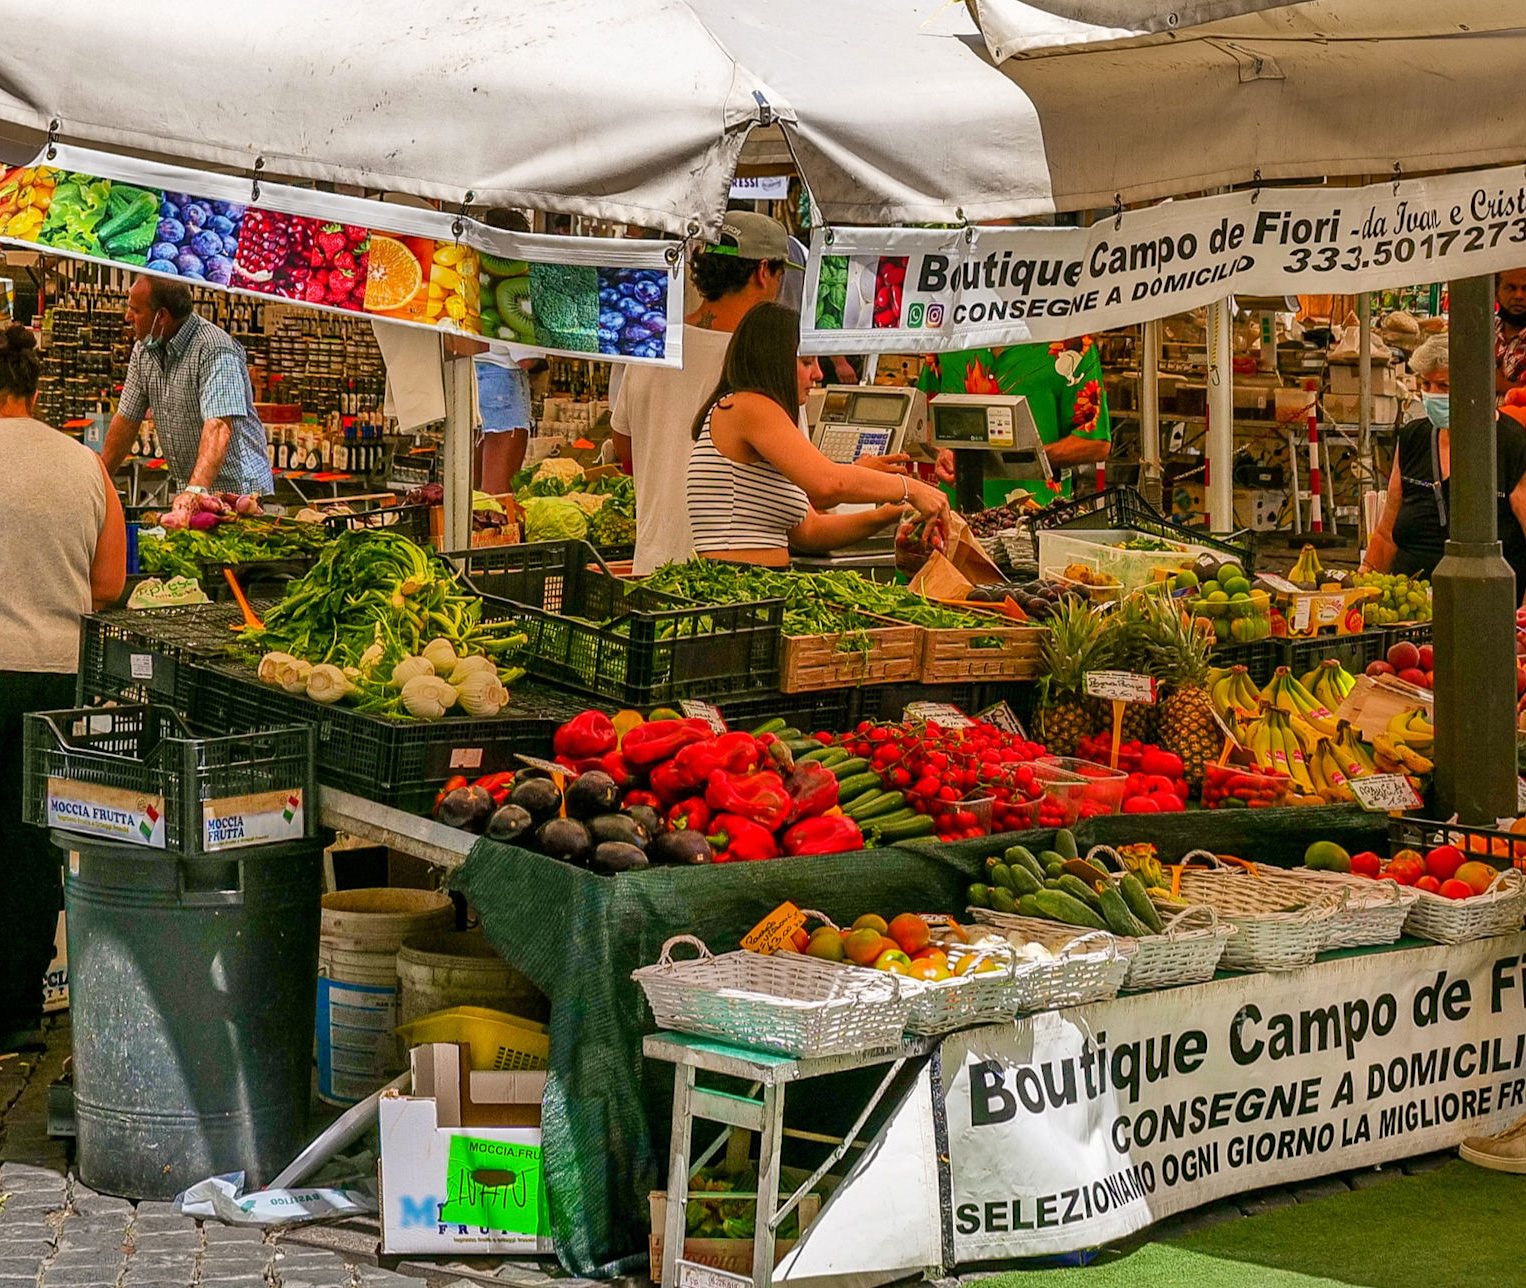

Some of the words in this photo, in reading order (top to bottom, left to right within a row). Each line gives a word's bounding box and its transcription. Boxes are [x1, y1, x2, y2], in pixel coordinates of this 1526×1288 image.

[916, 250, 1082, 296] Boutique
[1089, 232, 1198, 279] Campo
[1209, 217, 1245, 255] de
[1252, 209, 1341, 246] Fiori
[1393, 200, 1442, 238] Ivan
[1450, 204, 1464, 226] e
[952, 289, 1100, 325] CONSEGNE
[1105, 286, 1122, 307] A
[1131, 255, 1256, 302] DOMICILIO
[50, 799, 90, 819] MOCCIA
[93, 808, 135, 827] FRUTTA
[207, 815, 244, 830] MOCCIA
[208, 828, 245, 842] FRUTTA
[968, 1028, 1208, 1128] Boutique
[1229, 992, 1397, 1067] Campo
[1413, 970, 1472, 1029] de
[1111, 1076, 1322, 1155] CONSEGNE
[1331, 1070, 1354, 1110] A
[955, 1161, 1155, 1235] SELEZIONIAMO
[1162, 1141, 1219, 1186] OGNI
[1227, 1122, 1334, 1170] GIORNO
[1341, 1113, 1371, 1148] LA
[1379, 1085, 1493, 1140] MIGLIORE
